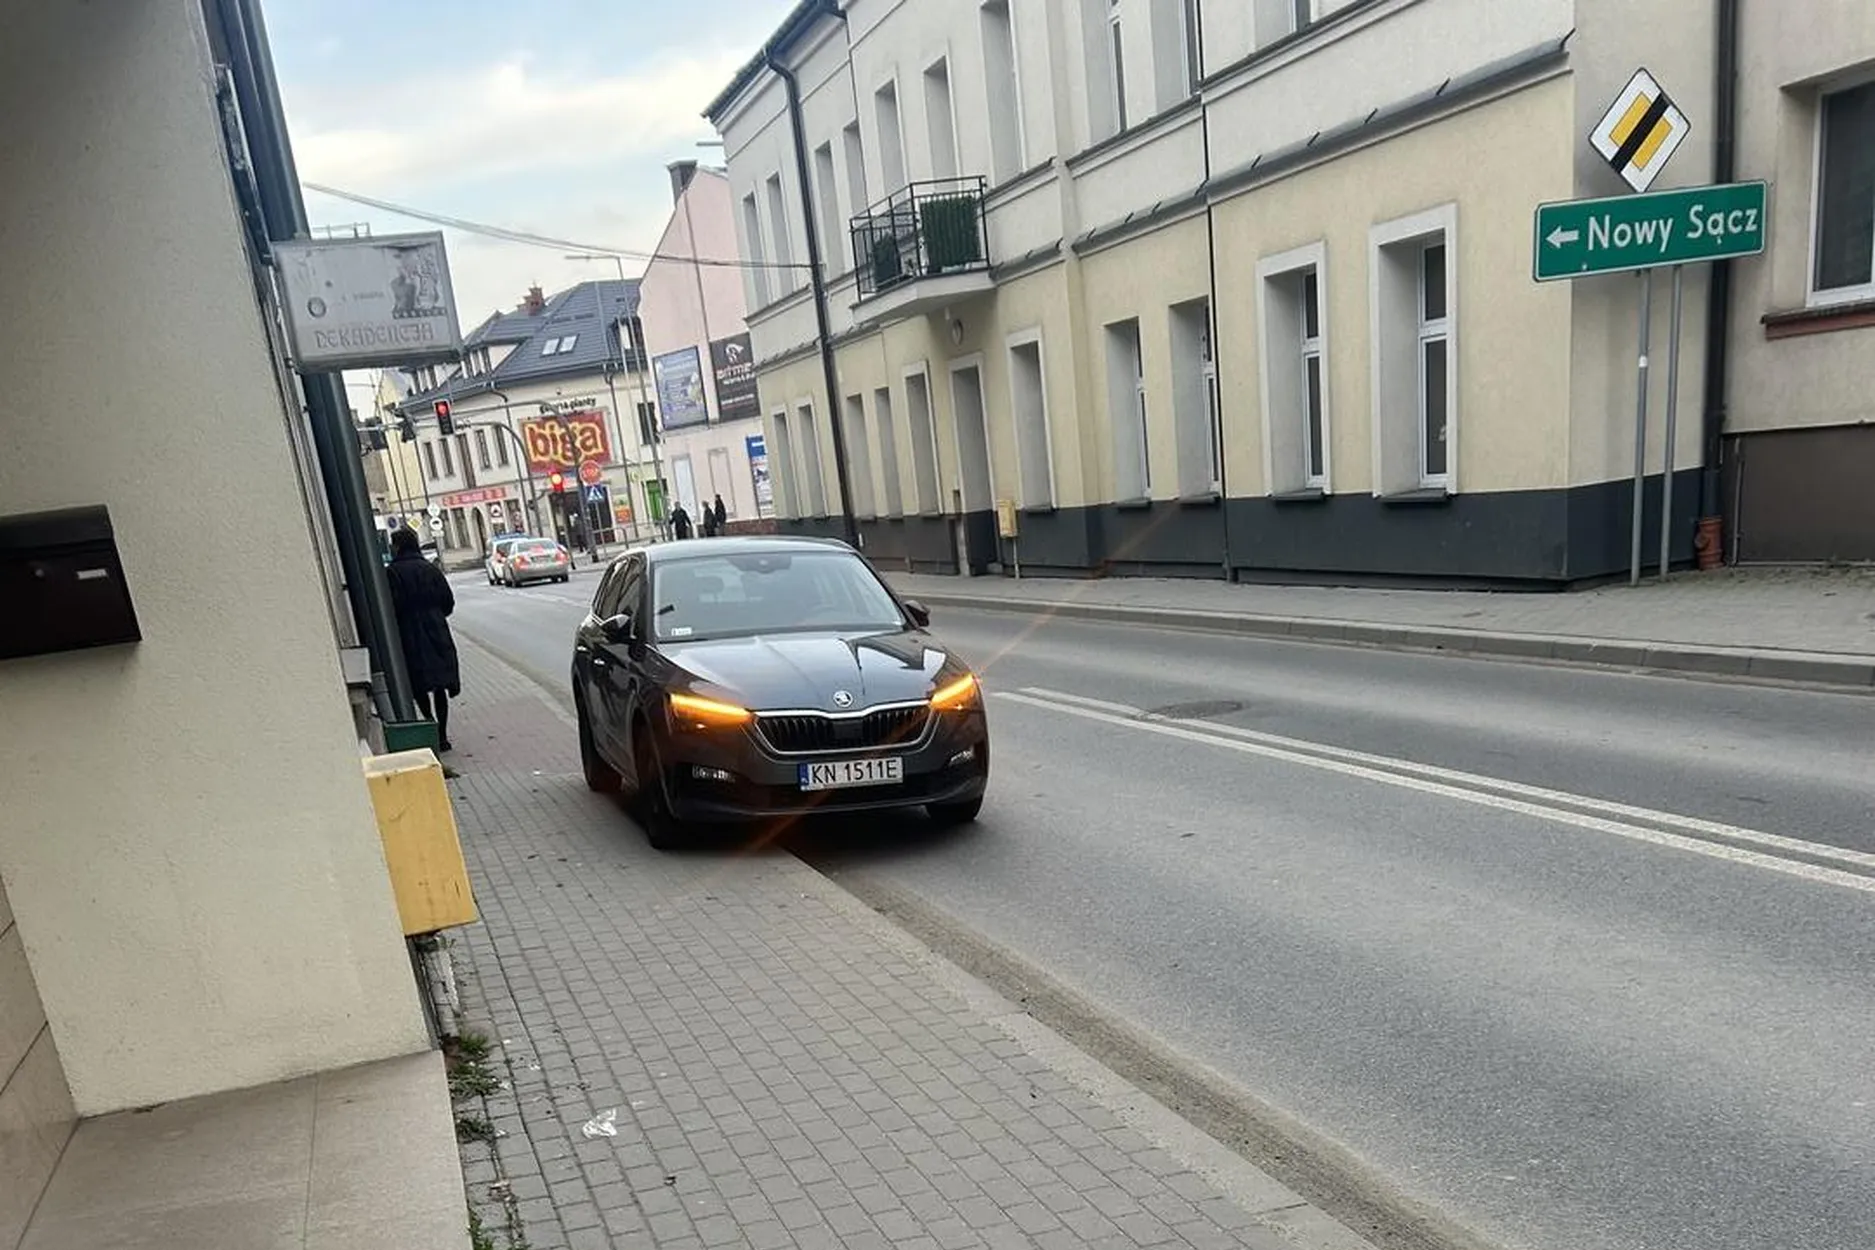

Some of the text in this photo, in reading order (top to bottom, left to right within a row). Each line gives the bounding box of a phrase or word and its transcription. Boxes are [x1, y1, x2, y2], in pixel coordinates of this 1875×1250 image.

[1588, 205, 1757, 252] Nowy Sącz
[315, 323, 434, 348] DEKADENCJA
[812, 760, 897, 783] KN 1511E
